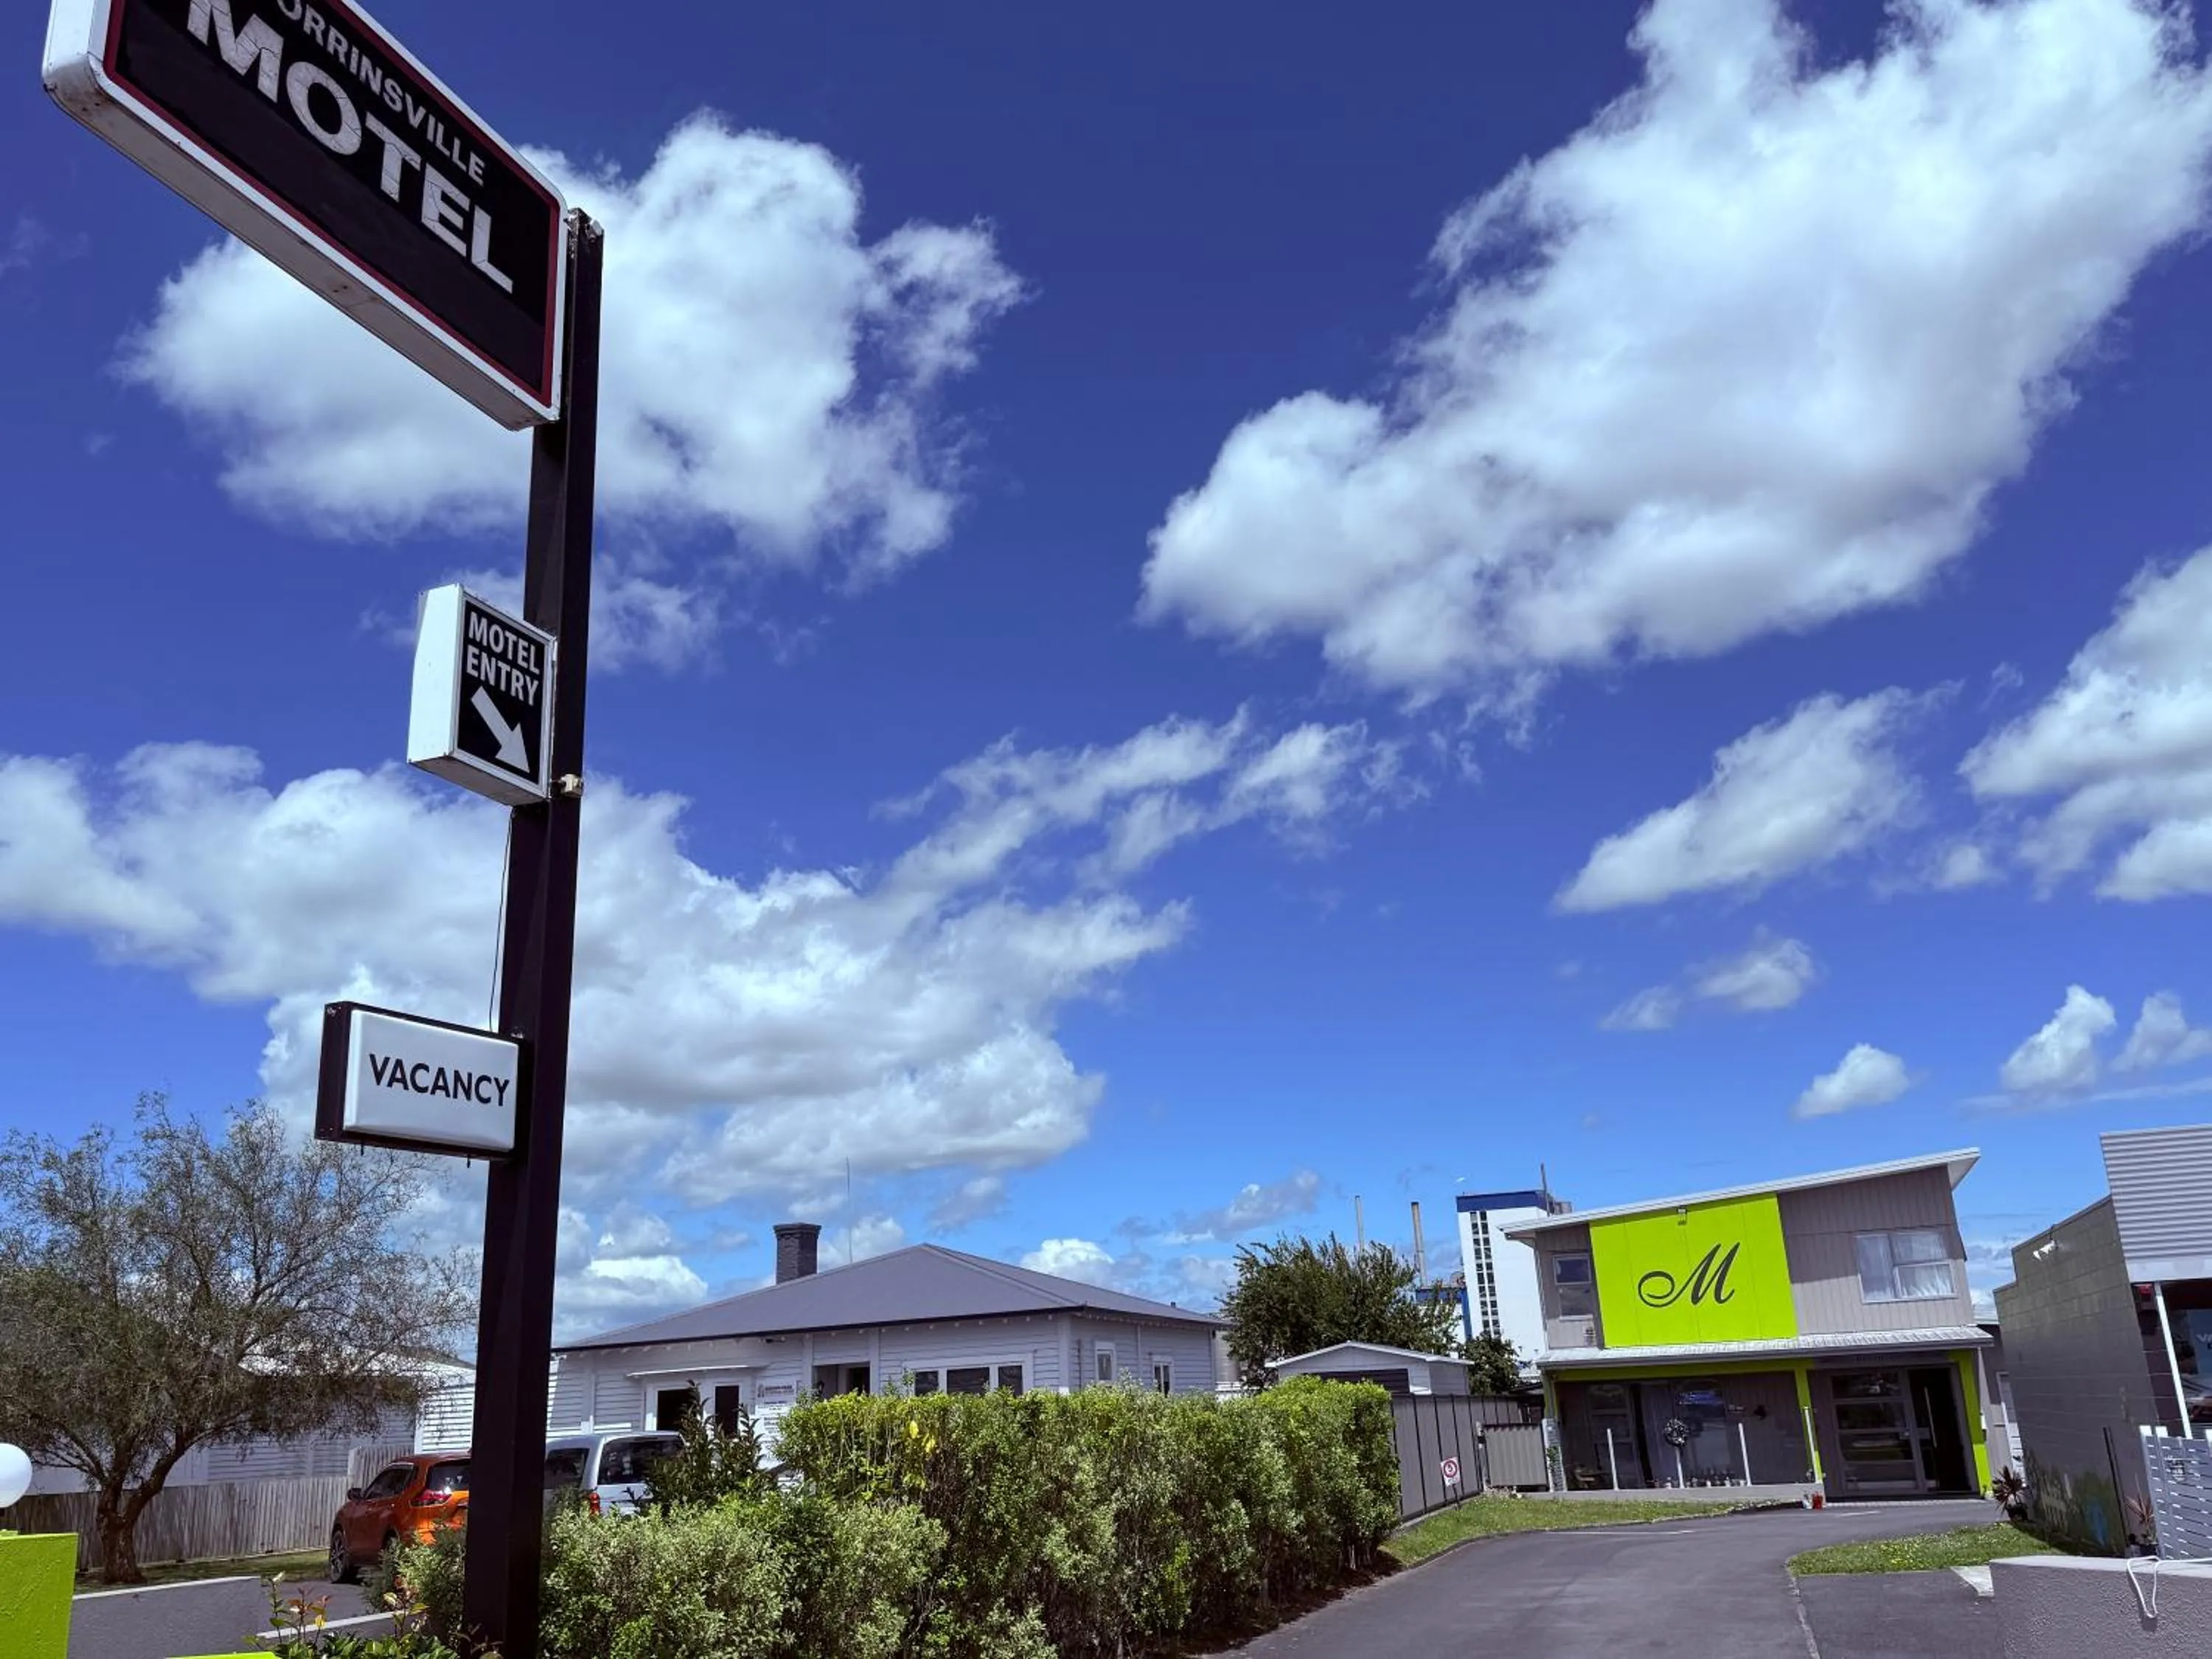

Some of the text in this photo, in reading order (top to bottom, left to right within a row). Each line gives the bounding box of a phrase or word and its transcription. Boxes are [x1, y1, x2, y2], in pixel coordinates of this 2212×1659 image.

[187, 0, 513, 294] MOTEL
[467, 644, 540, 706] ENTRY
[468, 611, 540, 675] MOTEL
[369, 1054, 510, 1107] VACANCY
[1638, 1242, 1741, 1308] M
